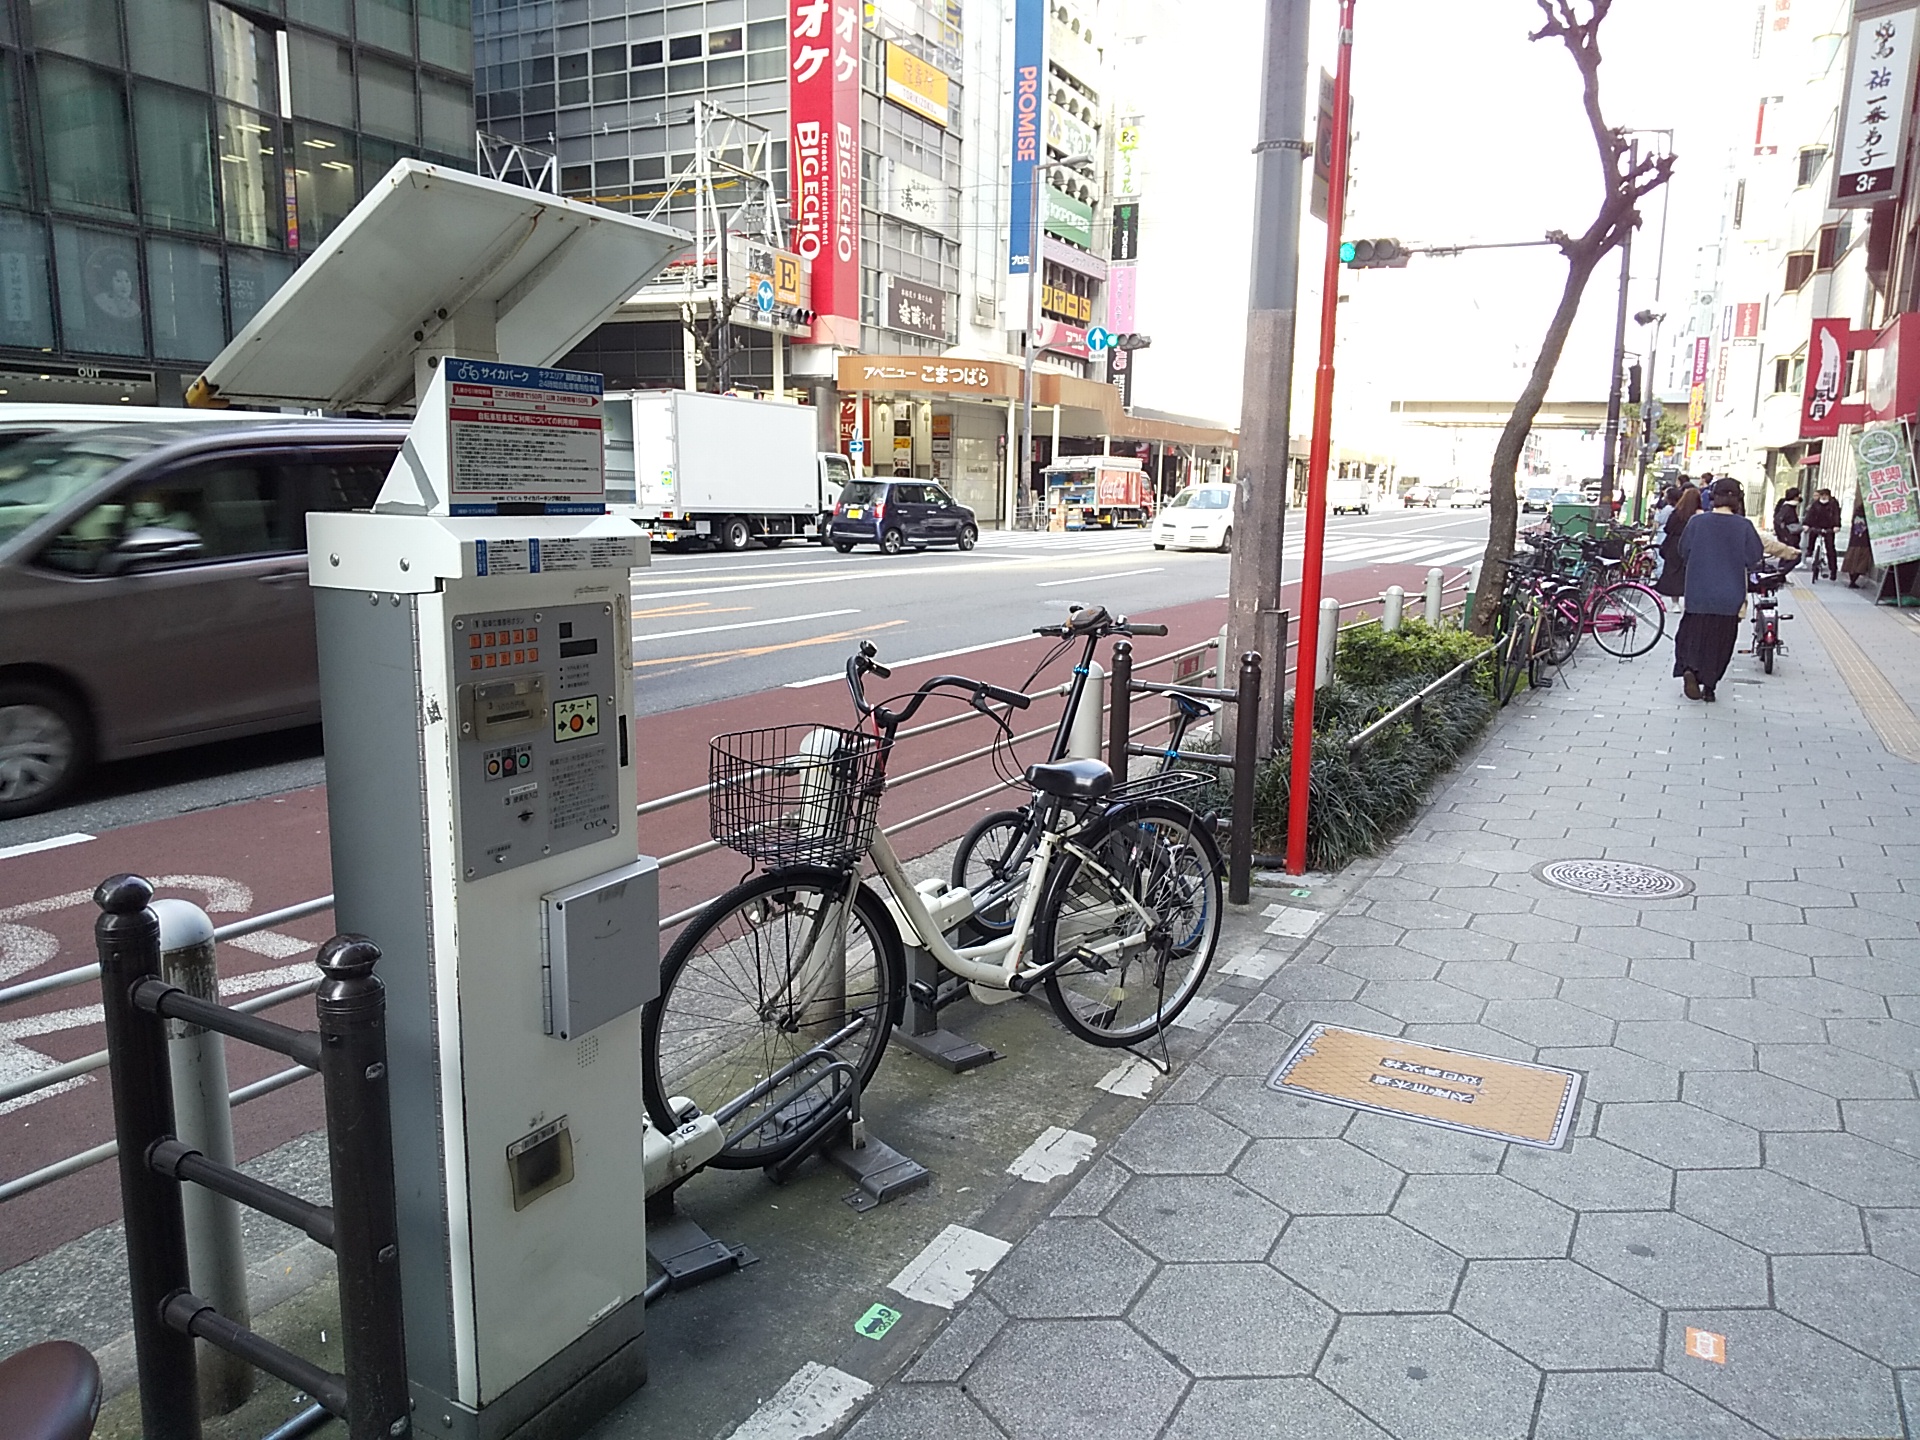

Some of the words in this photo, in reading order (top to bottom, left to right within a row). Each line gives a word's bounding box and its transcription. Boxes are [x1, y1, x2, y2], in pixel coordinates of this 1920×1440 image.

[1017, 66, 1037, 162] PROMISE
[797, 121, 820, 177] BIG
[821, 132, 829, 172] Karaoke
[1856, 173, 1878, 192] 3F
[821, 175, 829, 246] Entertainment
[798, 186, 821, 261] ECHO
[779, 258, 796, 293] E
[78, 367, 101, 379] OUT
[481, 367, 530, 382] サイカパーク
[539, 371, 565, 380] キタエリア
[863, 366, 917, 380] アベニュー
[921, 365, 989, 387] こまつばら
[560, 700, 592, 714] スタート
[584, 818, 608, 830] CYCA
